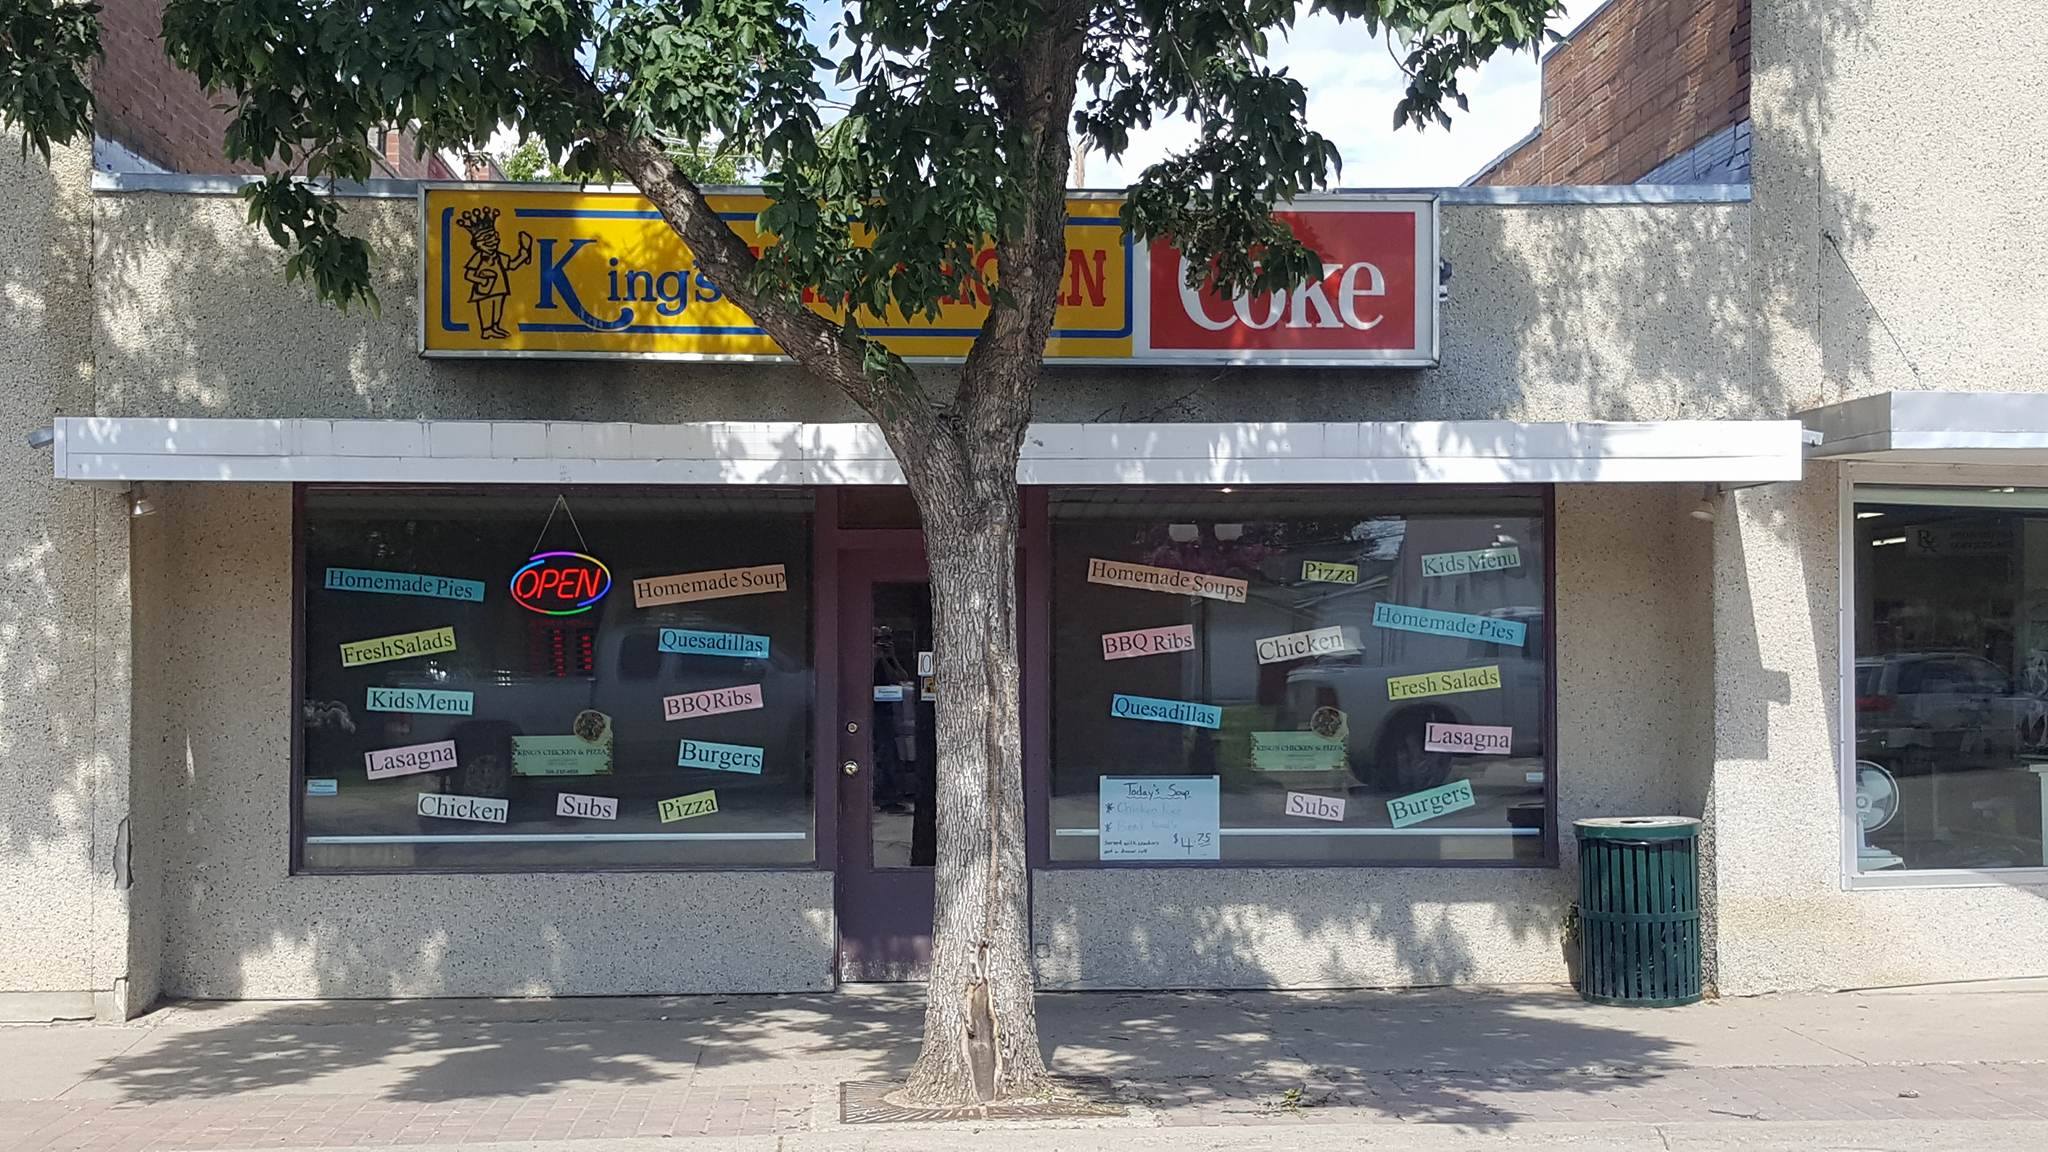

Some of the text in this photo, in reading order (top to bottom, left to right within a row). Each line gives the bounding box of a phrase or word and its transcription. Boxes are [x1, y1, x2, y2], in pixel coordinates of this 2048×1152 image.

[1177, 252, 1386, 330] Coke
[1304, 562, 1356, 583] Pizza
[1423, 550, 1518, 575] Kids Menu
[329, 570, 473, 599] Homemade Pies
[516, 568, 601, 599] OPEN
[637, 570, 786, 599] Homemade Soup
[1091, 561, 1245, 600] Homemade Soups
[1376, 605, 1515, 641] Homemade Pies
[661, 629, 764, 653] Quesadillas
[1104, 631, 1193, 654] BBQ Ribs
[1258, 632, 1342, 661] Chicken
[1389, 669, 1499, 697] Fresh Salads
[666, 691, 753, 716] BBQ Ribs
[1114, 696, 1215, 725] Quesadillas
[1428, 725, 1510, 751] Lasagna
[367, 746, 454, 772] Lasagna
[681, 741, 761, 769] Burgers
[1123, 782, 1160, 800] Today's
[1392, 785, 1471, 821] Burgers
[419, 795, 506, 822] Chicken
[562, 795, 612, 818] Subs
[661, 796, 716, 820] Pizza
[1291, 794, 1340, 818] Subs
